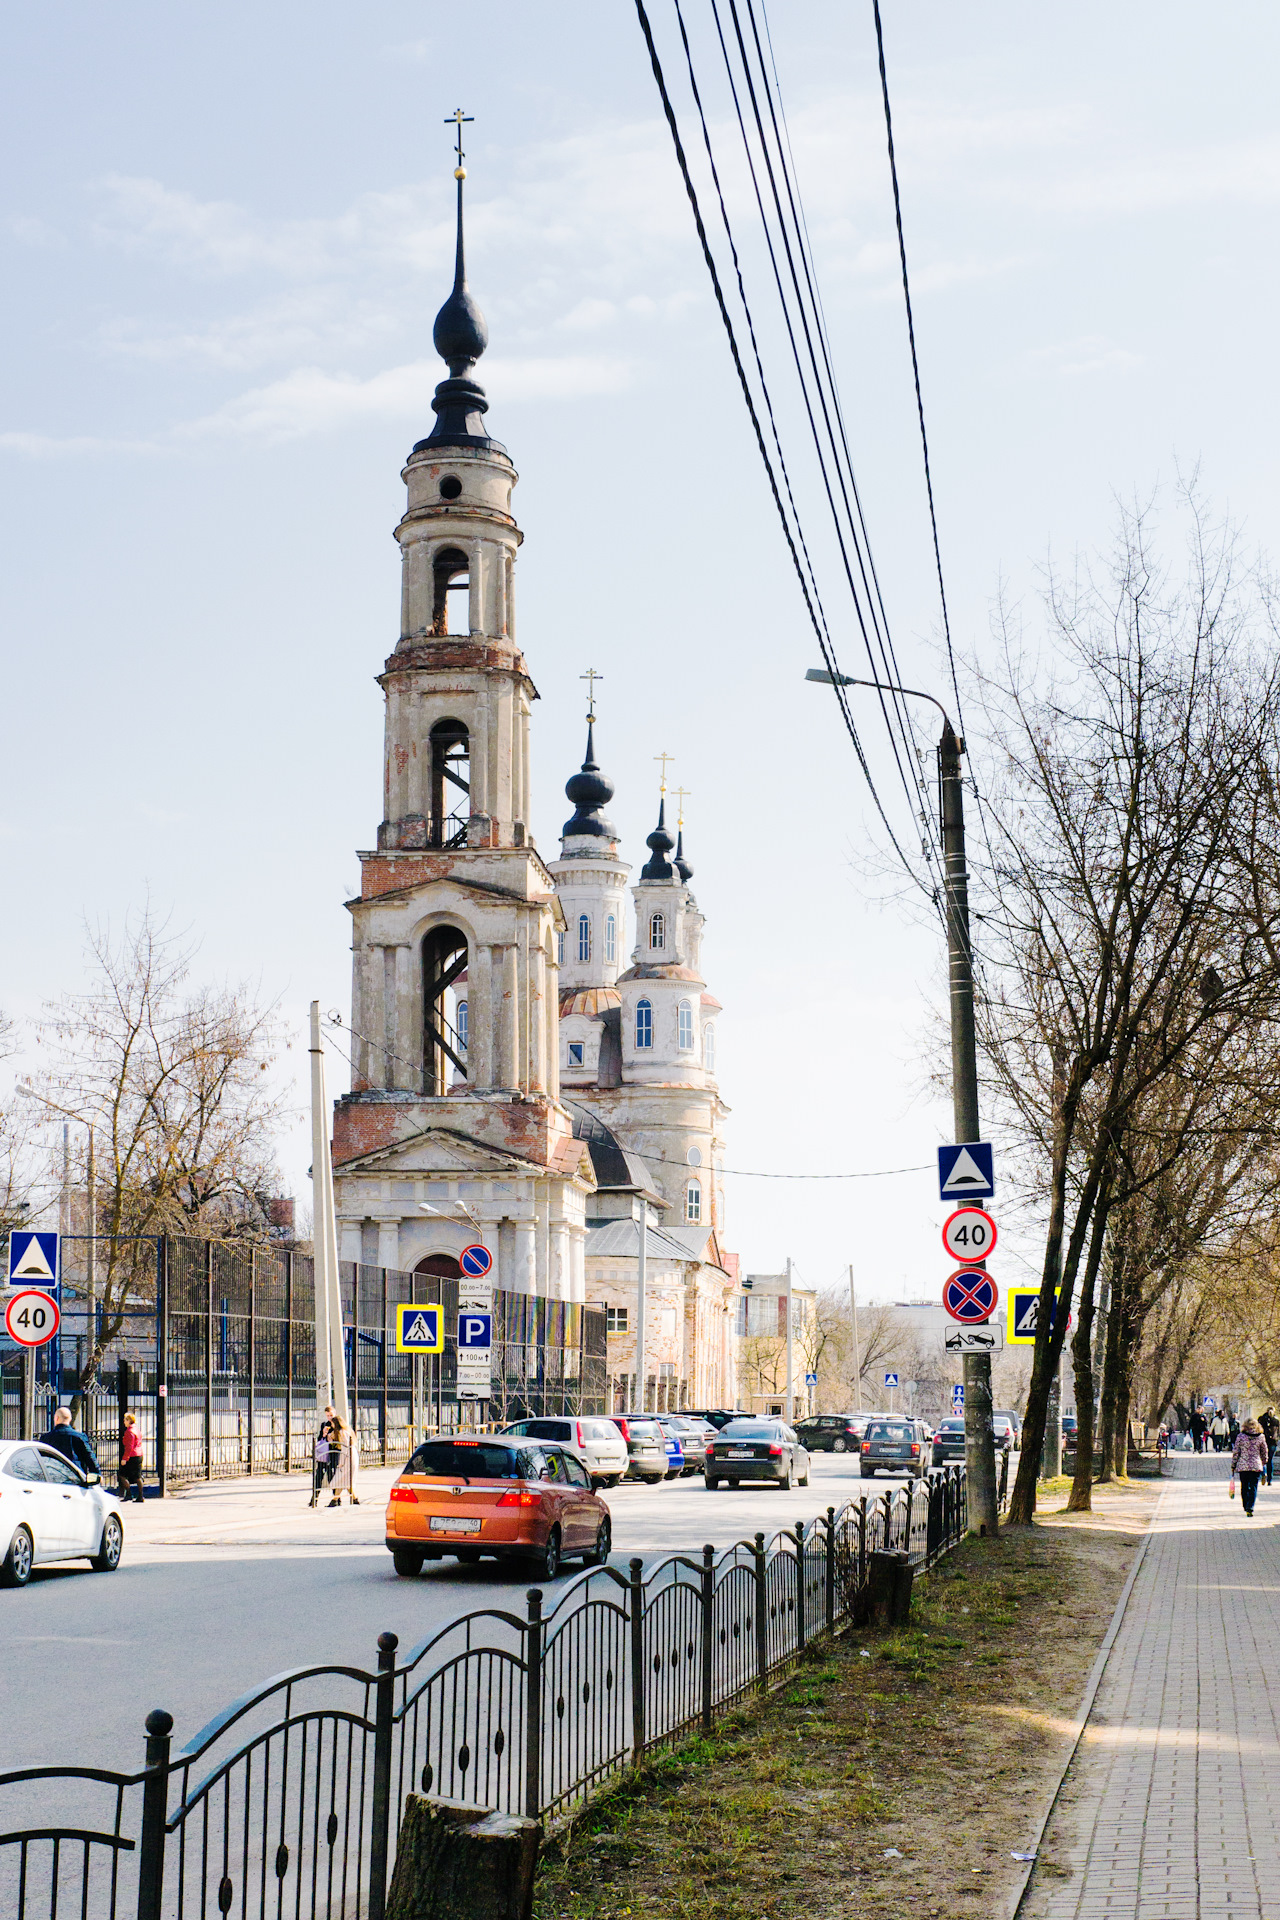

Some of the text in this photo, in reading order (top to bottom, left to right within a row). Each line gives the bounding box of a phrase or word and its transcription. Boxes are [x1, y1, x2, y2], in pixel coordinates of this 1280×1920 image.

[954, 1224, 986, 1246] 40
[16, 1307, 46, 1329] 40
[466, 1318, 485, 1344] P
